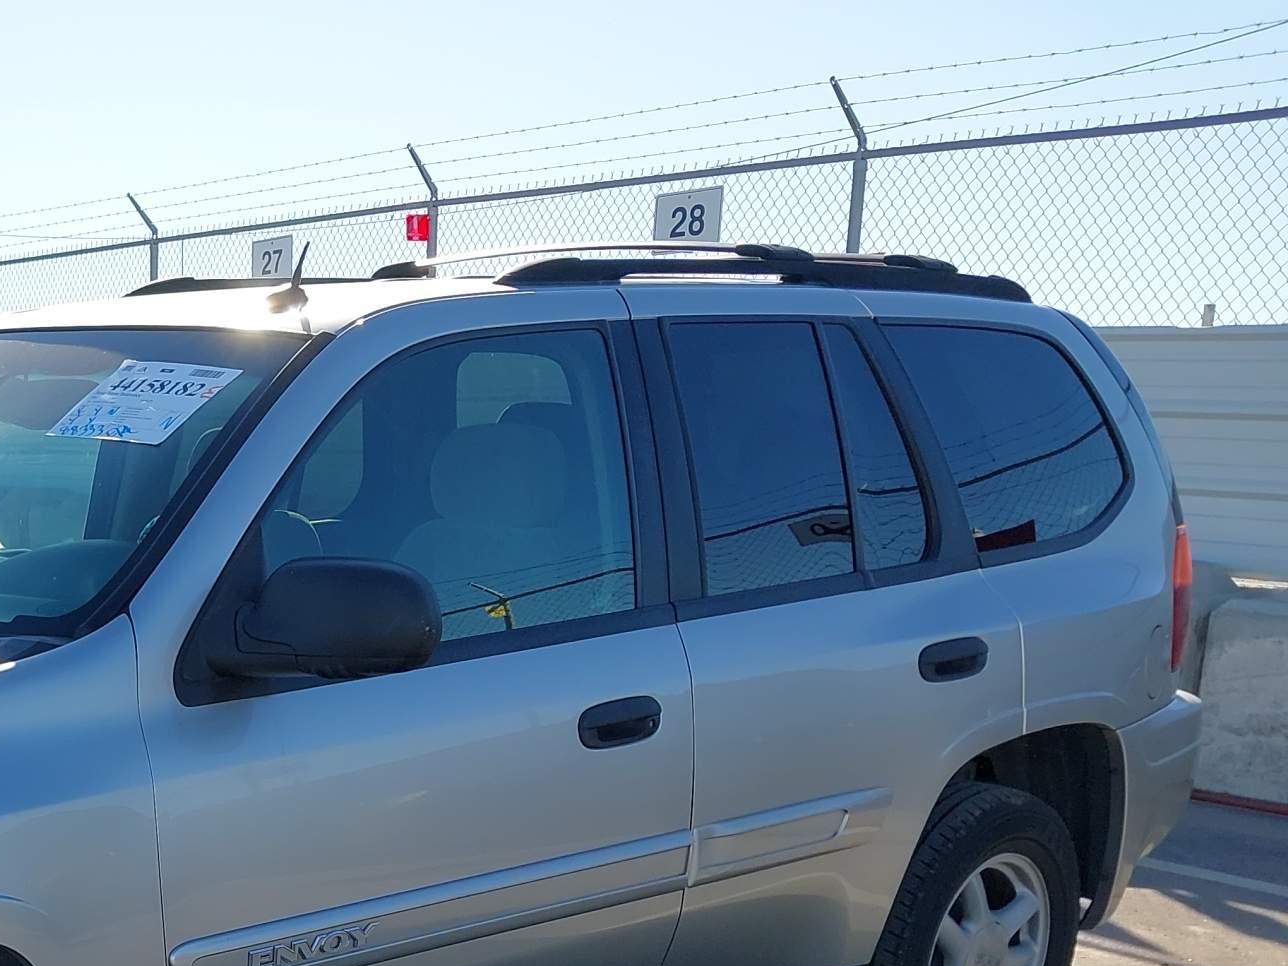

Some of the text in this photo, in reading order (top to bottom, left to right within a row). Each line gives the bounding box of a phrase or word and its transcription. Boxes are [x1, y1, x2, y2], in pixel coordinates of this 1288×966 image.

[669, 203, 706, 238] 28
[262, 249, 283, 275] 27
[109, 376, 206, 398] 44158182
